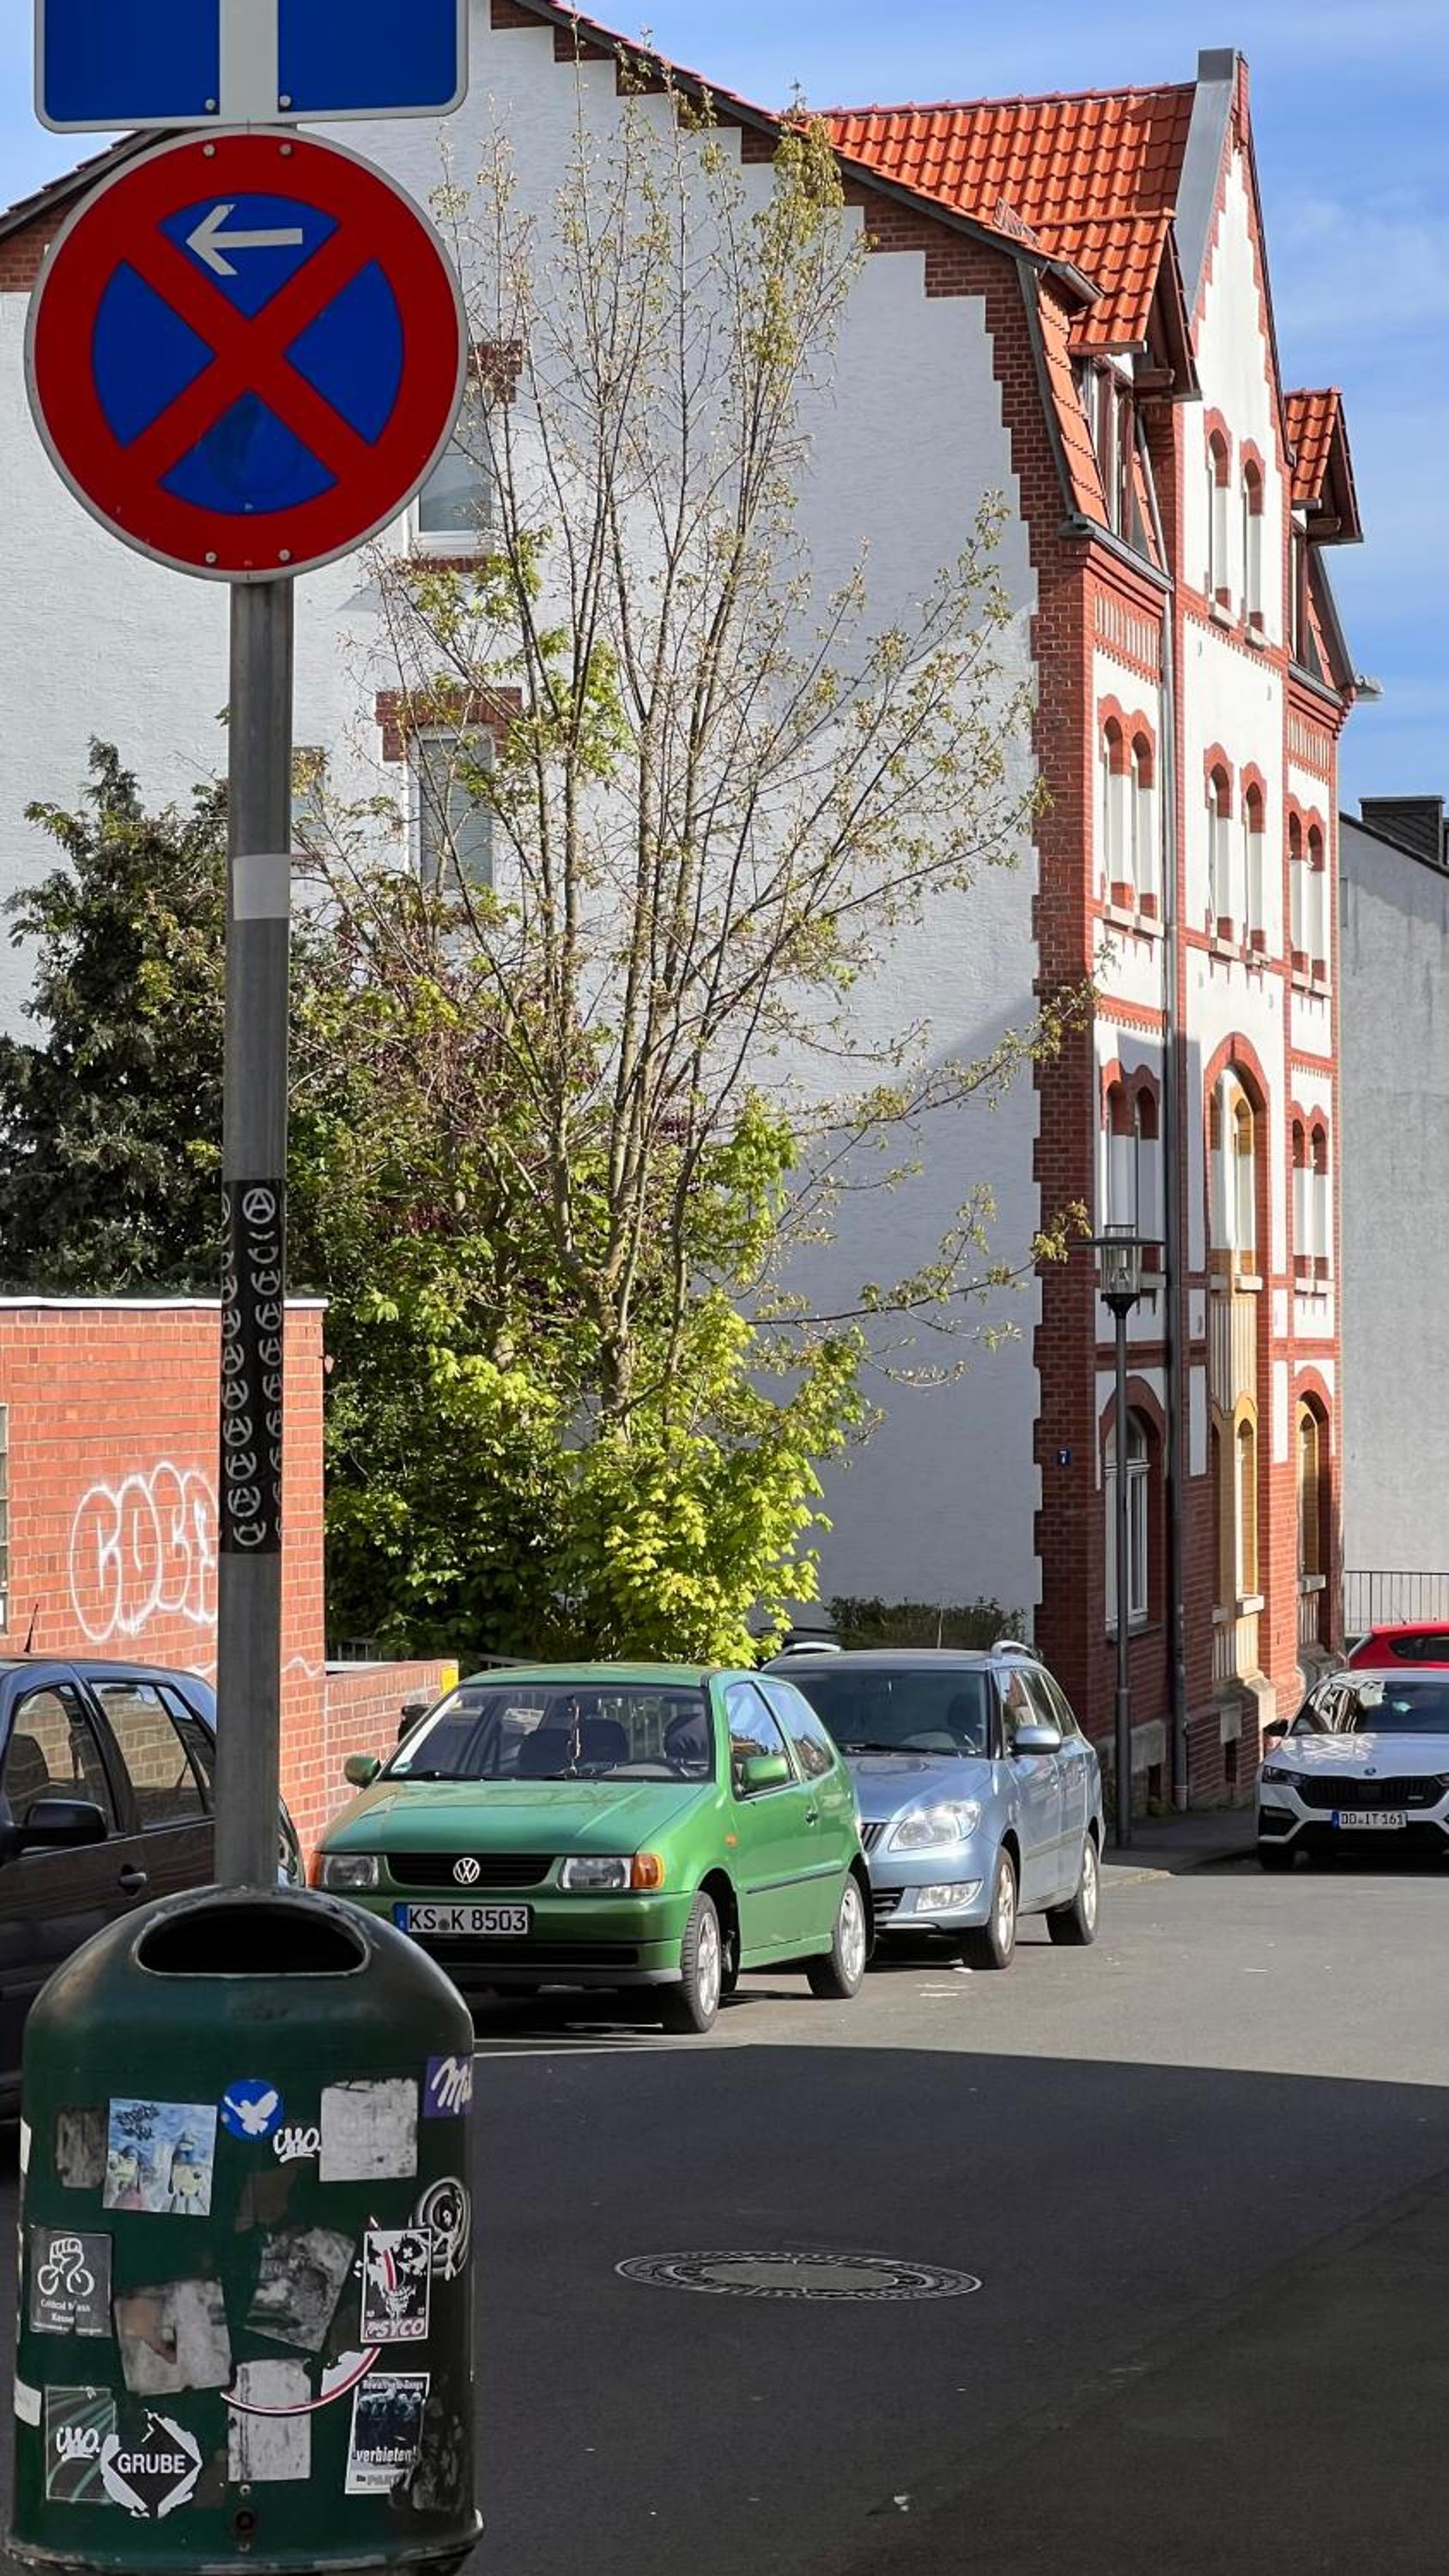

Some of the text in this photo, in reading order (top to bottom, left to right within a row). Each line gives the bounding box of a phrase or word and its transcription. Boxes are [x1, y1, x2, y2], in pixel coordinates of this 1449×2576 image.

[1341, 1814, 1356, 1825] DD
[409, 1909, 526, 1930] KS K 8503
[366, 2318, 425, 2338] PSYCO
[118, 2453, 186, 2474] GRUBE
